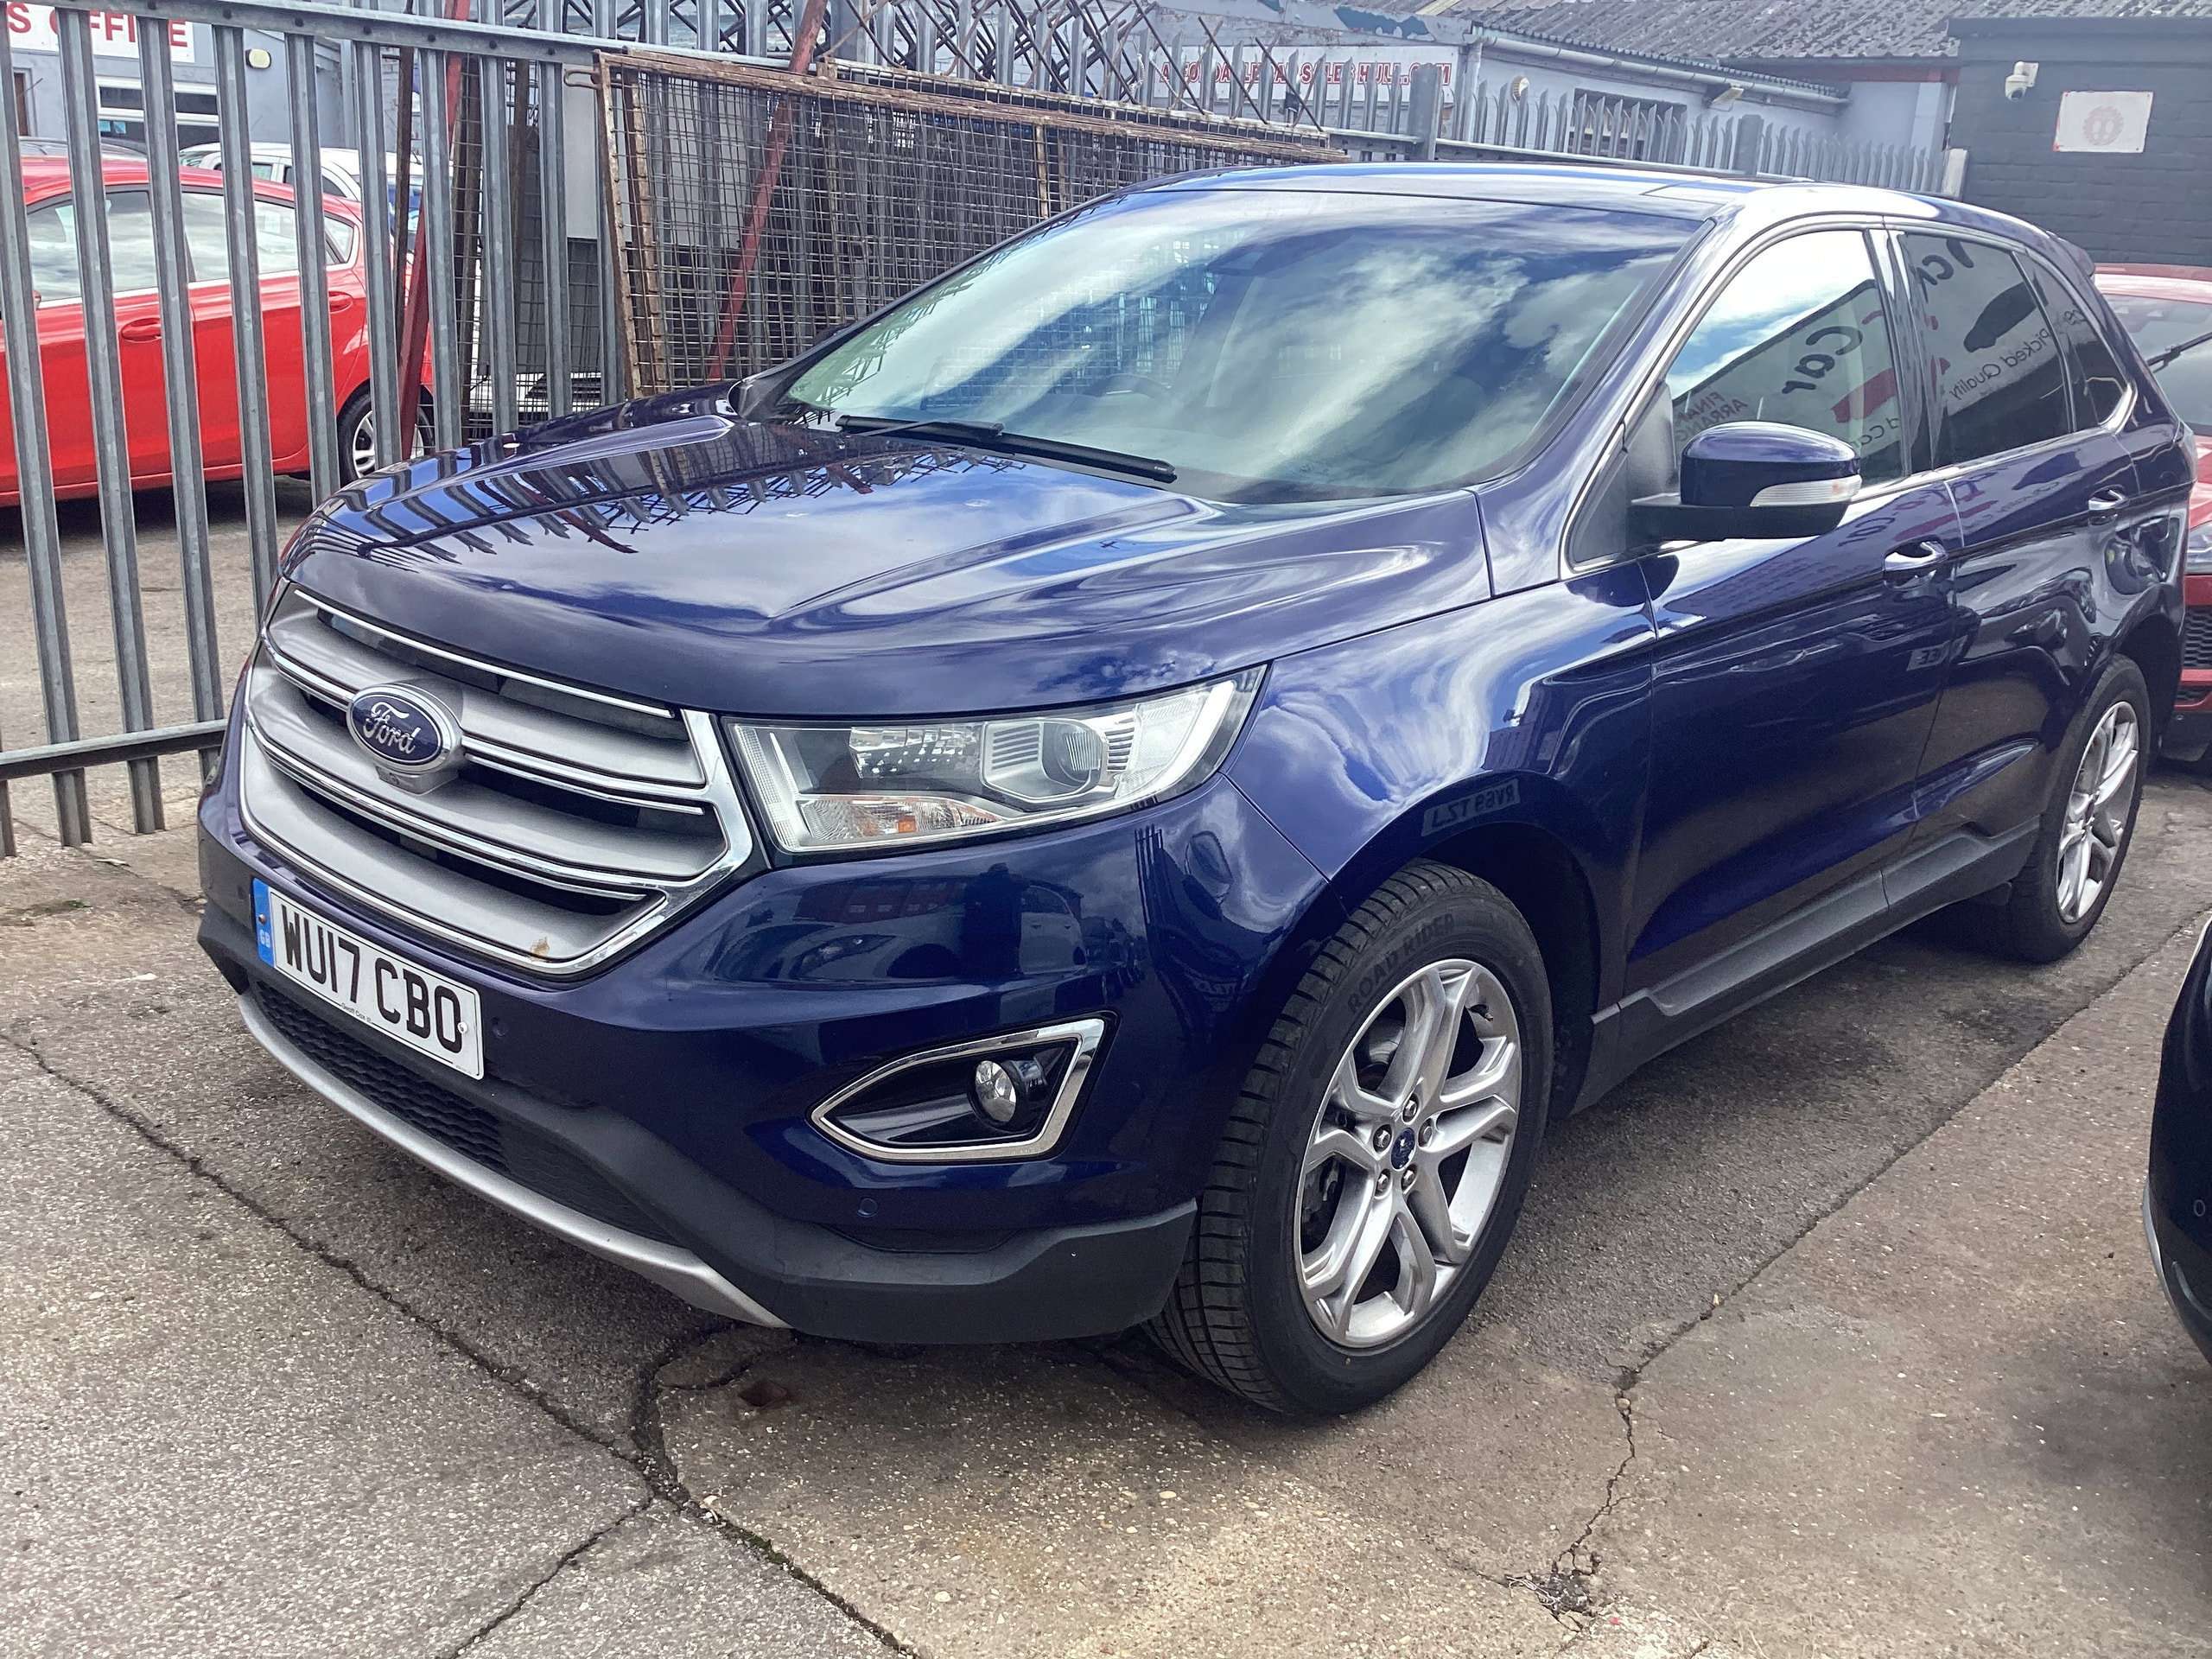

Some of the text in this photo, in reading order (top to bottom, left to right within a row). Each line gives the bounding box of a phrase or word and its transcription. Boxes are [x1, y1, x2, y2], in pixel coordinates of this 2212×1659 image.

[363, 702, 422, 754] Ford
[258, 929, 271, 948] GB
[281, 904, 463, 1054] WU17 CBO
